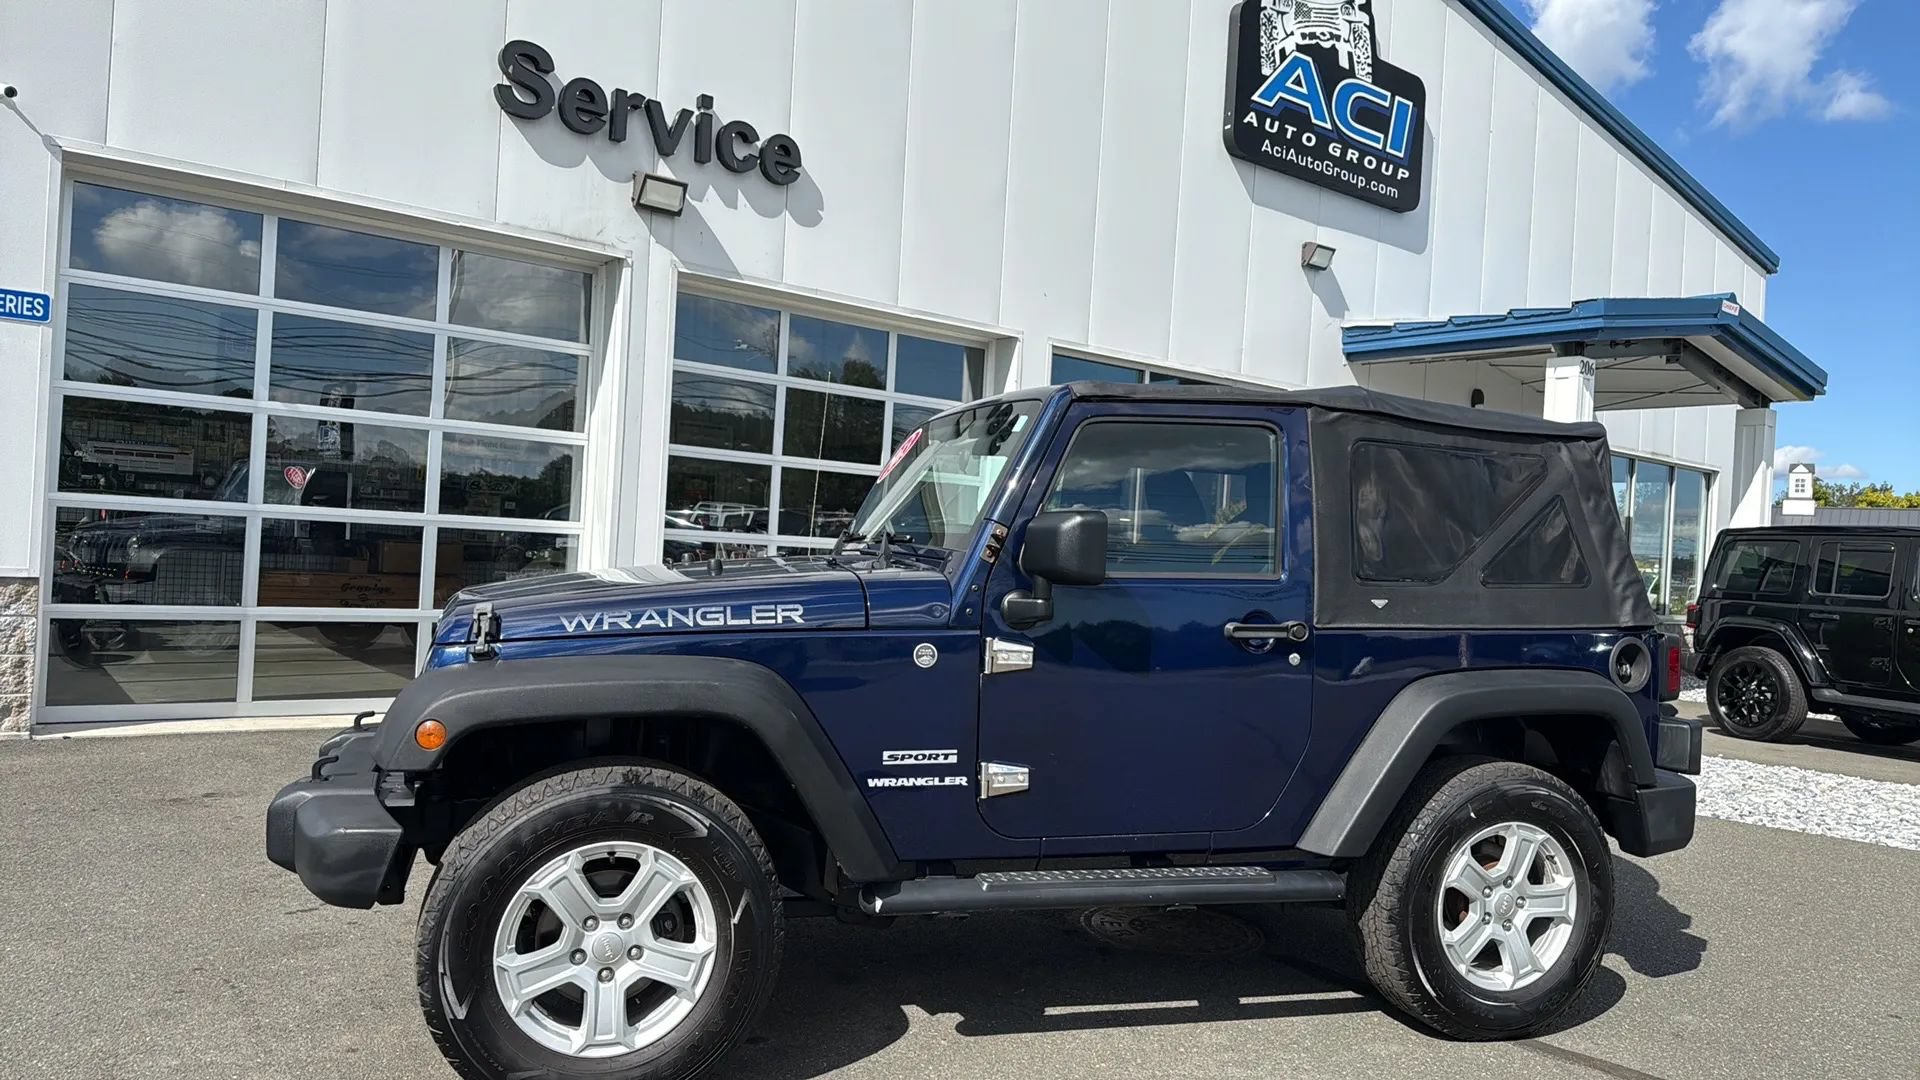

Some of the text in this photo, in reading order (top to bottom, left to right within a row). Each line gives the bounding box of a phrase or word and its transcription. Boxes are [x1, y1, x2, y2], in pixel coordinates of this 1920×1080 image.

[493, 40, 802, 186] Service
[1250, 50, 1416, 161] ACI
[1243, 111, 1410, 181] AUTO GROUP
[1261, 139, 1399, 199] AciAutoGroup.com
[1579, 359, 1595, 377] 206
[559, 604, 806, 633] WRANGLER
[884, 751, 957, 763] SPORT
[867, 776, 969, 787] WRANGLER
